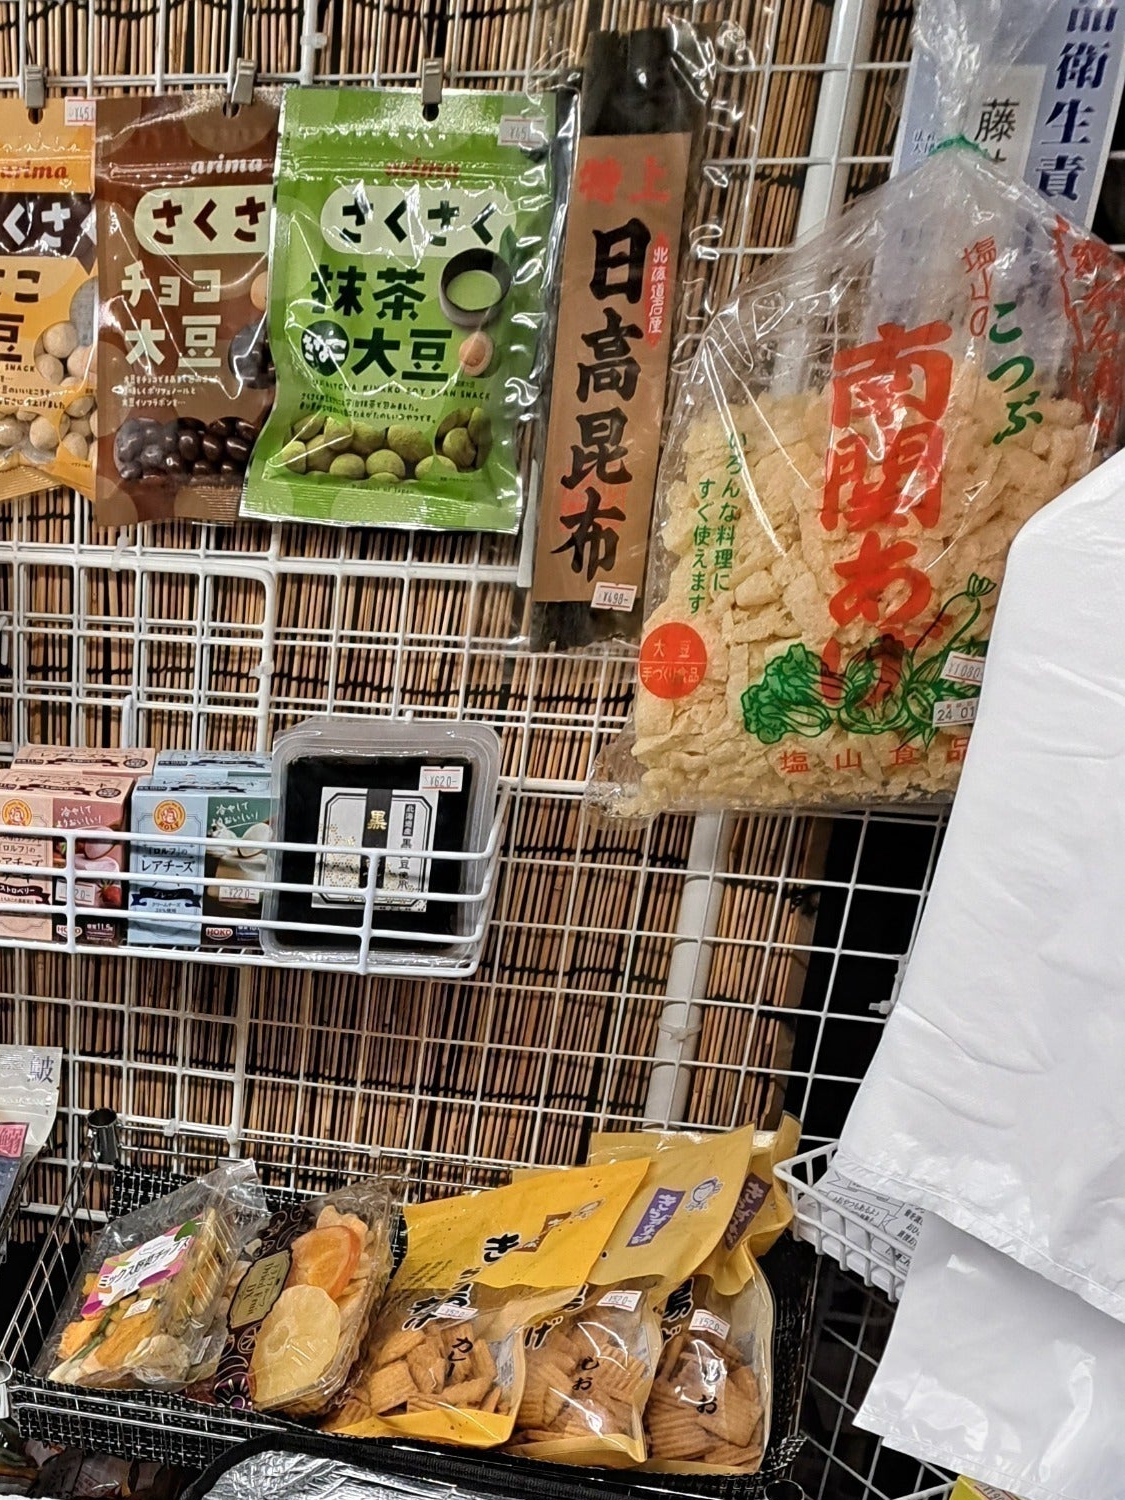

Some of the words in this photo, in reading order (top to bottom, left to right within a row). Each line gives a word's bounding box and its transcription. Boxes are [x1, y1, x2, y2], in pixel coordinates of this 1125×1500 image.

[1, 163, 68, 181] arima
[190, 155, 264, 176] arima
[383, 160, 460, 178] arima
[341, 199, 495, 245] さくさく
[121, 261, 221, 308] チョコ
[311, 265, 427, 320] 抹茶
[124, 314, 222, 368] 大豆
[353, 329, 452, 383] 大豆
[5, 364, 35, 373] SNACK
[987, 301, 1043, 445] こつぶ
[551, 218, 650, 583] 日高昆布
[711, 431, 748, 591] いろんな料理に
[687, 478, 716, 616] すぐ使えます
[652, 639, 694, 659] 大豆
[641, 667, 701, 687] 手づくり食品
[367, 810, 388, 830] 黒
[142, 860, 195, 874] レアチーズ
[206, 927, 233, 937] HOKO
[446, 1336, 474, 1378] カレー
[573, 1356, 599, 1391] しお
